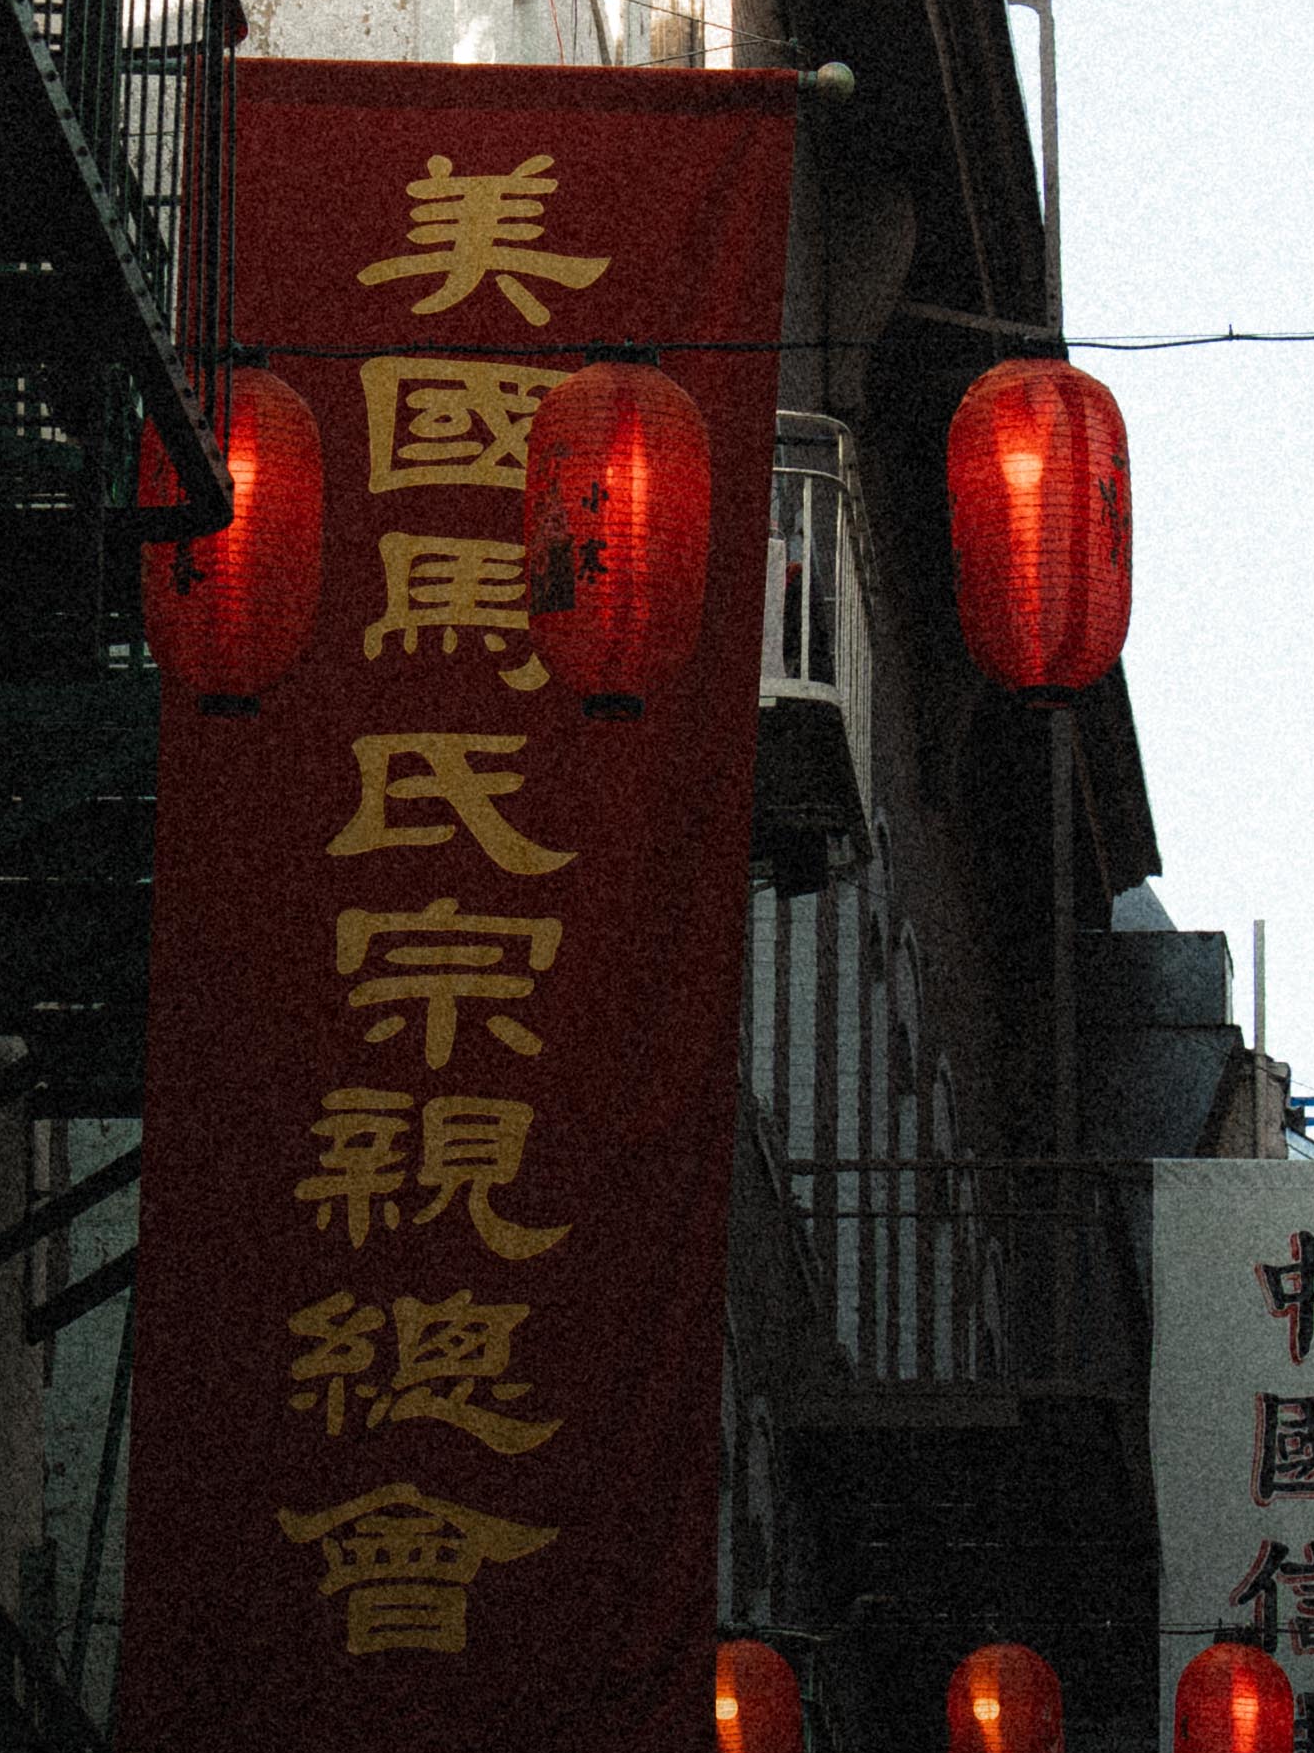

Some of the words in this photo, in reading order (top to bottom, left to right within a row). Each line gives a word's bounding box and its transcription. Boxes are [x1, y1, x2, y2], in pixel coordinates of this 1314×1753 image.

[277, 153, 613, 1656] 美國馬氏宗親總會
